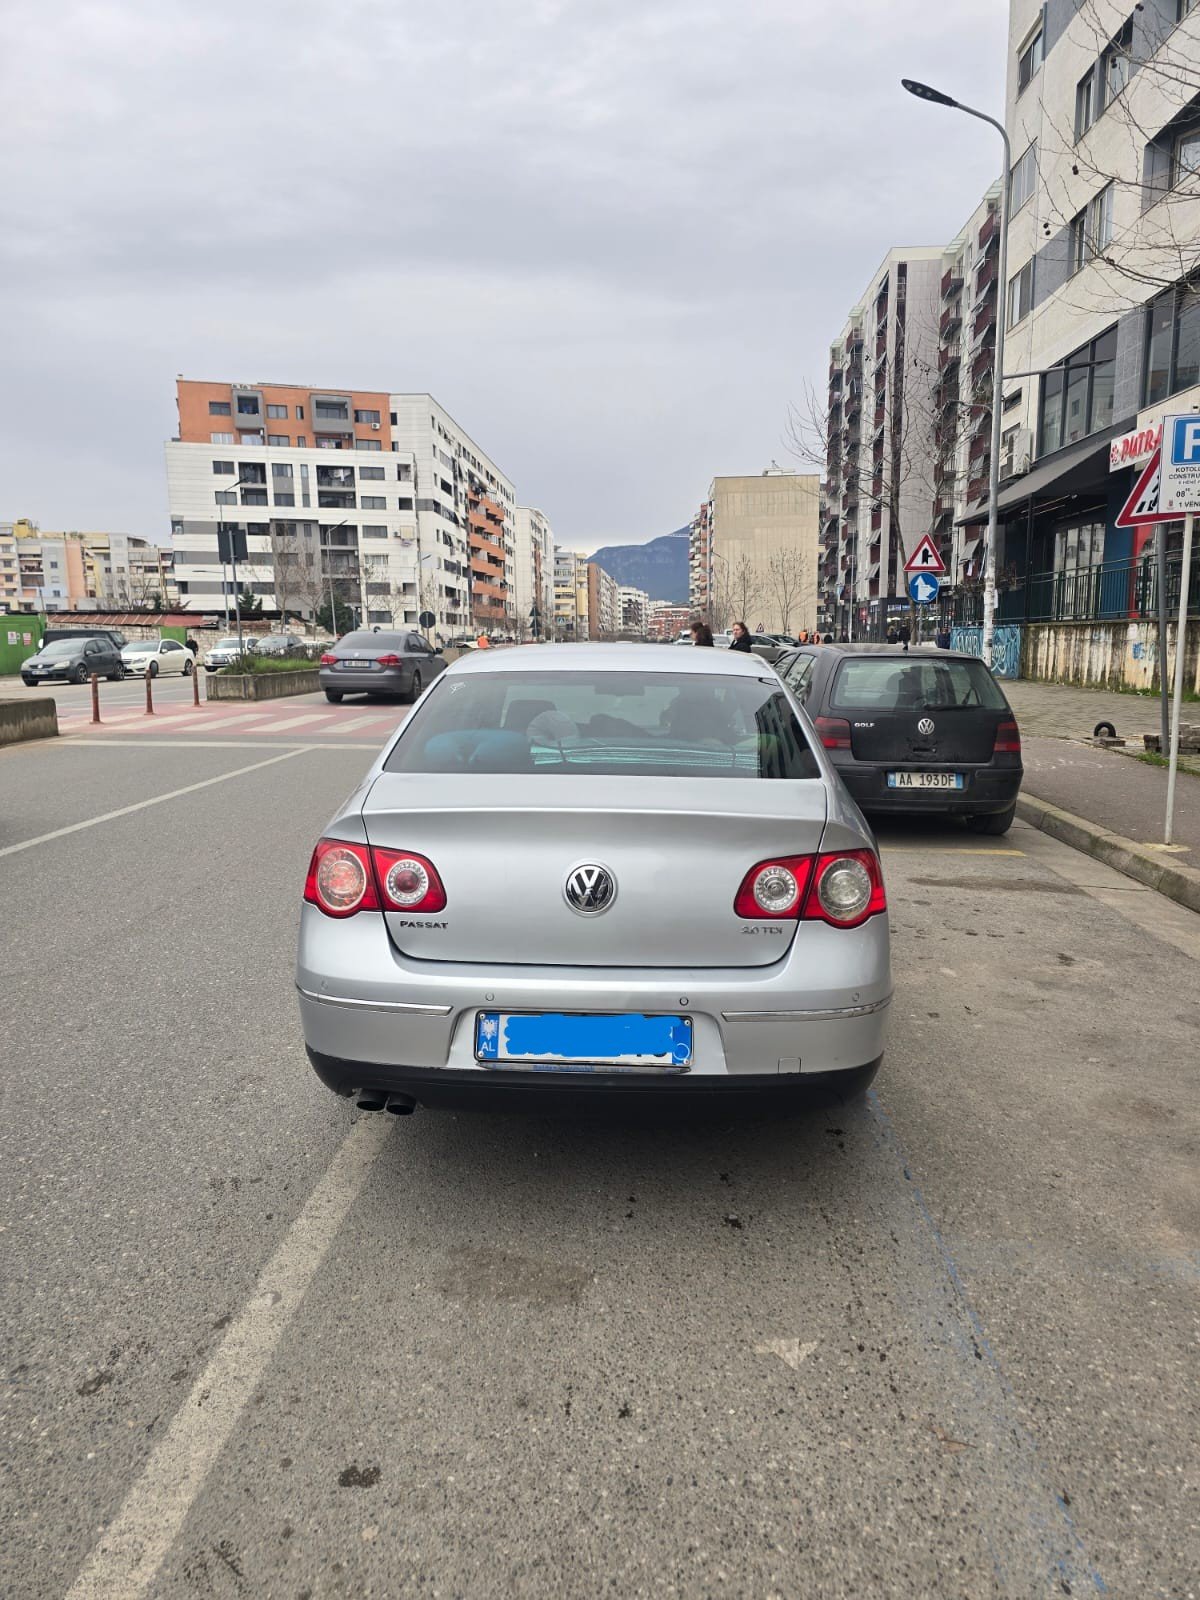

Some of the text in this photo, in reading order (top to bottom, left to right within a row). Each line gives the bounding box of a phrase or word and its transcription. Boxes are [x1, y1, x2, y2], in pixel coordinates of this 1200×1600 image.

[899, 774, 913, 786] AA
[400, 920, 448, 929] PASSAT
[761, 926, 783, 934] TDI
[481, 1041, 496, 1052] AL
